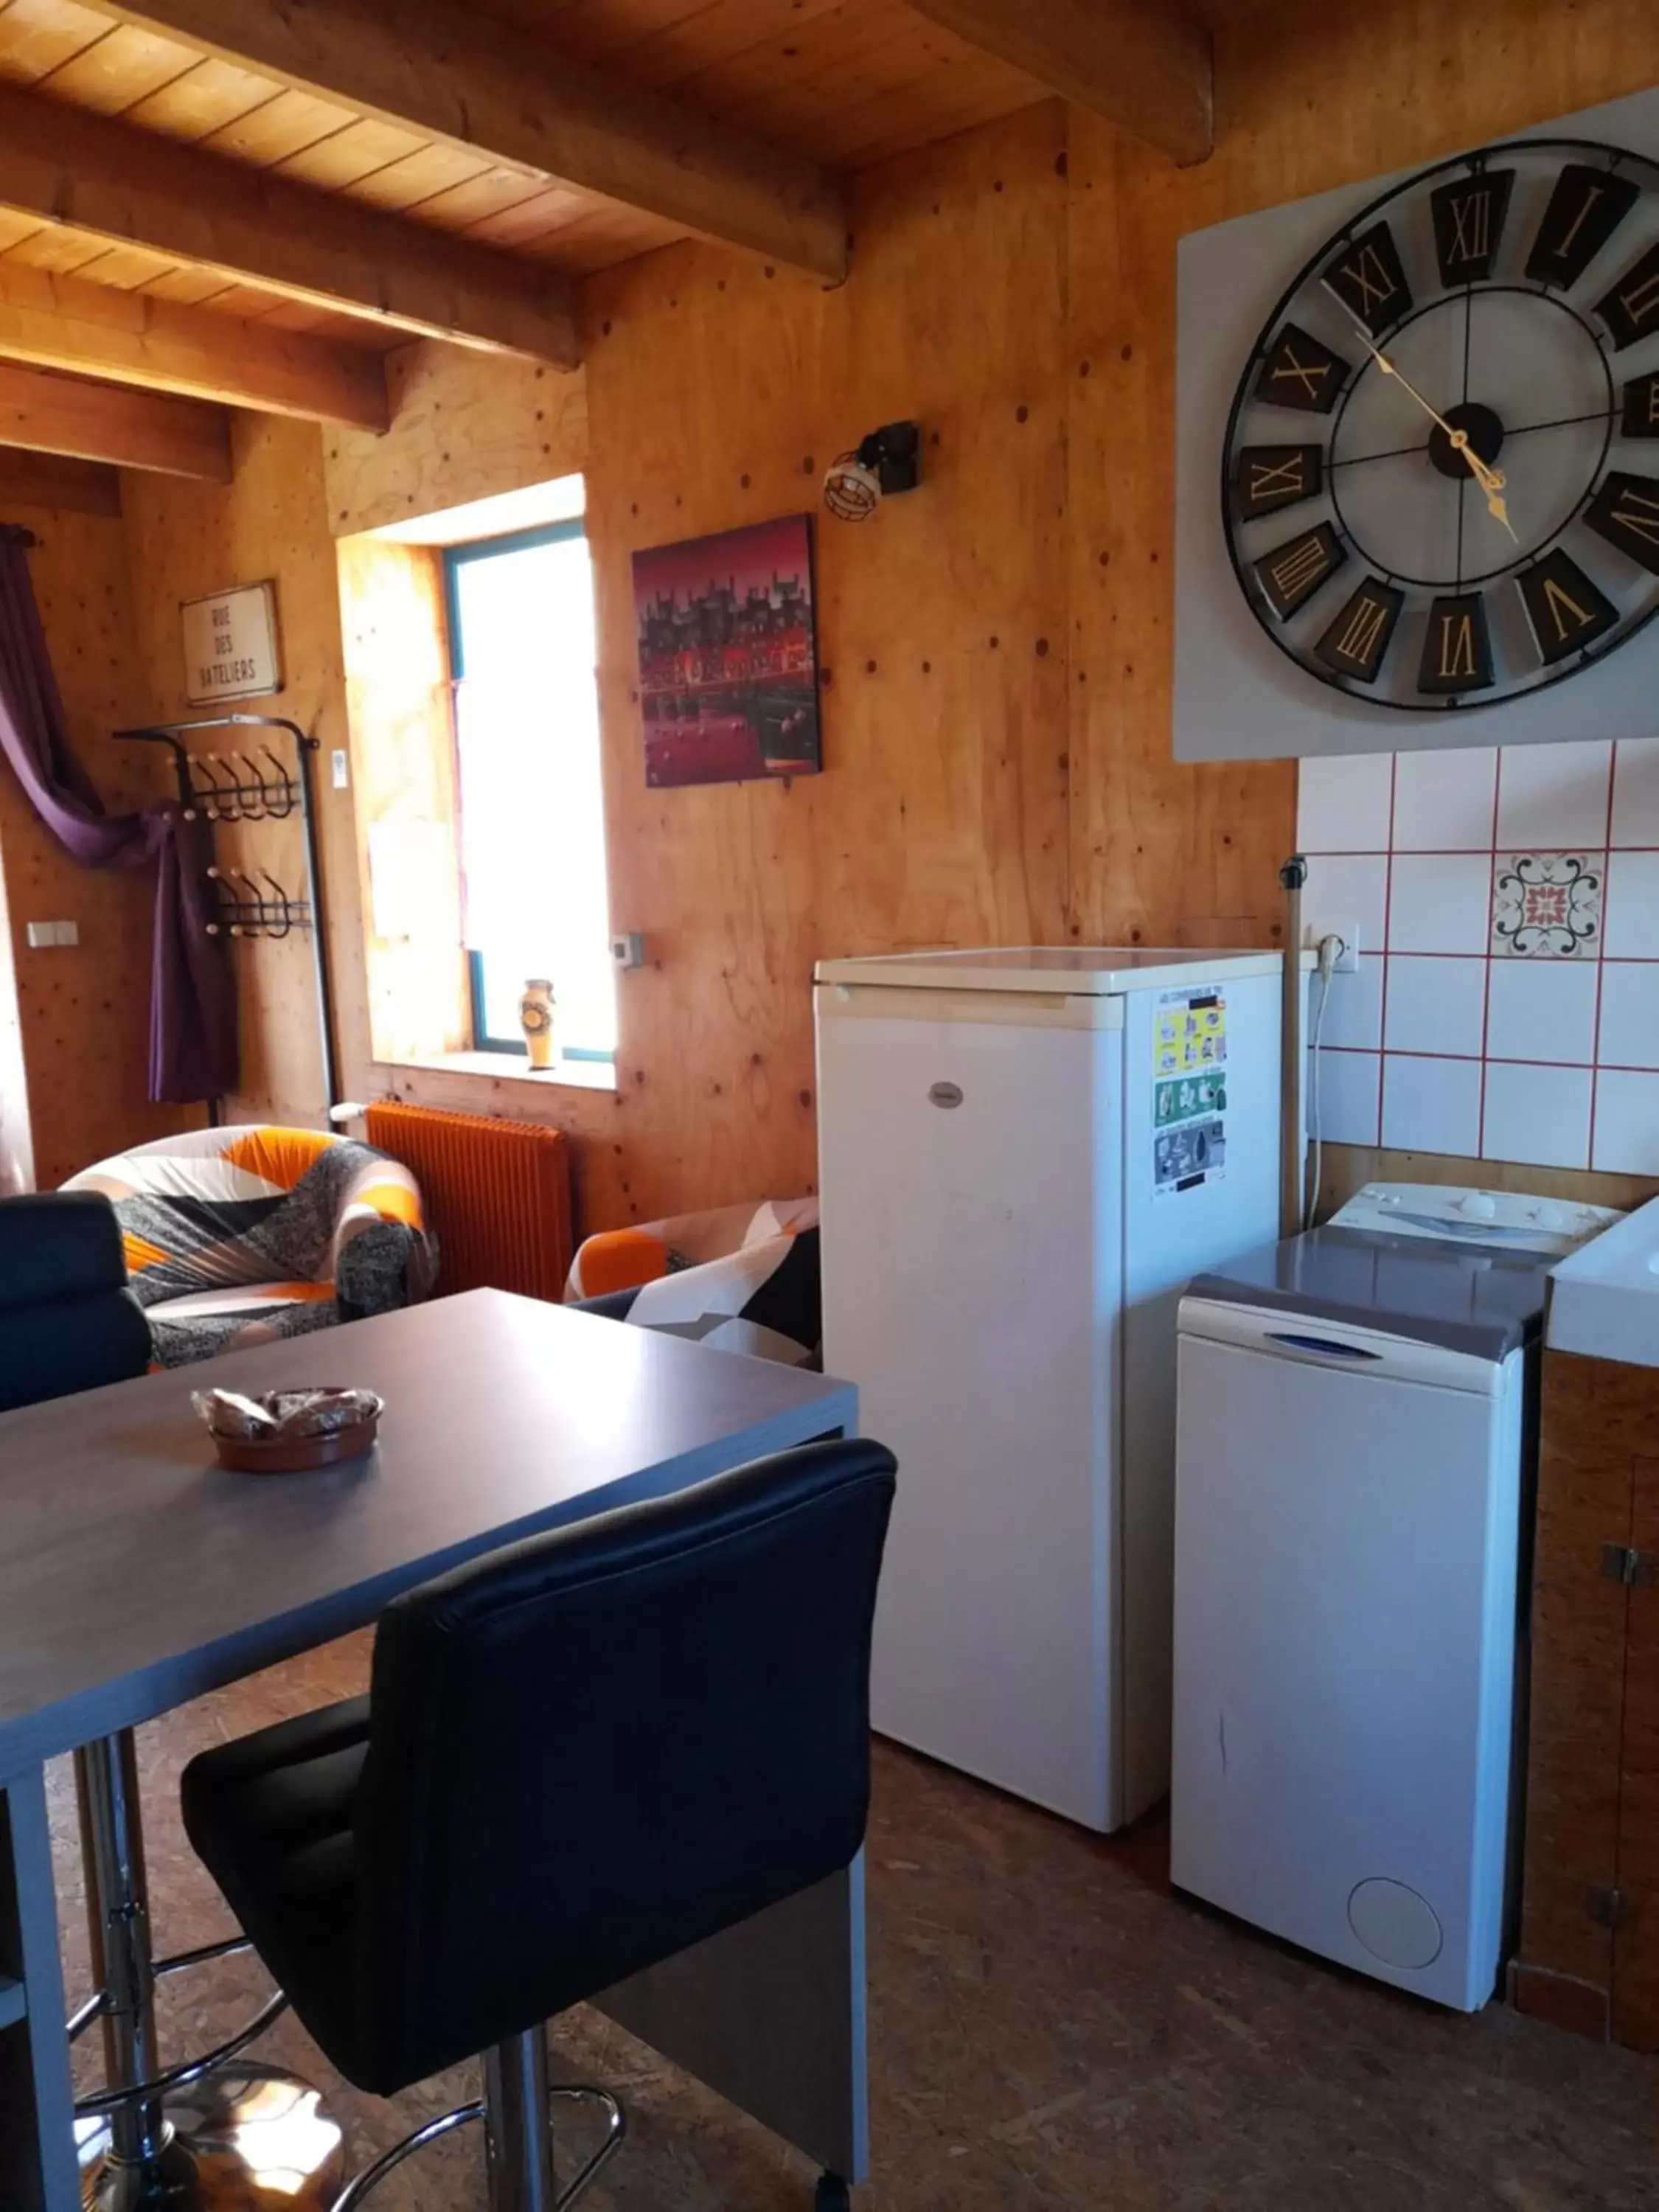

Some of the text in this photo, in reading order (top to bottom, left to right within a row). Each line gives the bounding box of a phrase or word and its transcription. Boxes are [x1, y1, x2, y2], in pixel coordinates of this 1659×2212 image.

[1448, 191, 1491, 265] XII
[1554, 186, 1604, 258] I
[1342, 246, 1397, 317] XI
[1272, 344, 1329, 400] X
[1251, 453, 1302, 500] IX
[212, 605, 230, 627] RUE
[1544, 578, 1596, 642] V
[215, 635, 233, 655] DES
[1439, 615, 1476, 676] VI
